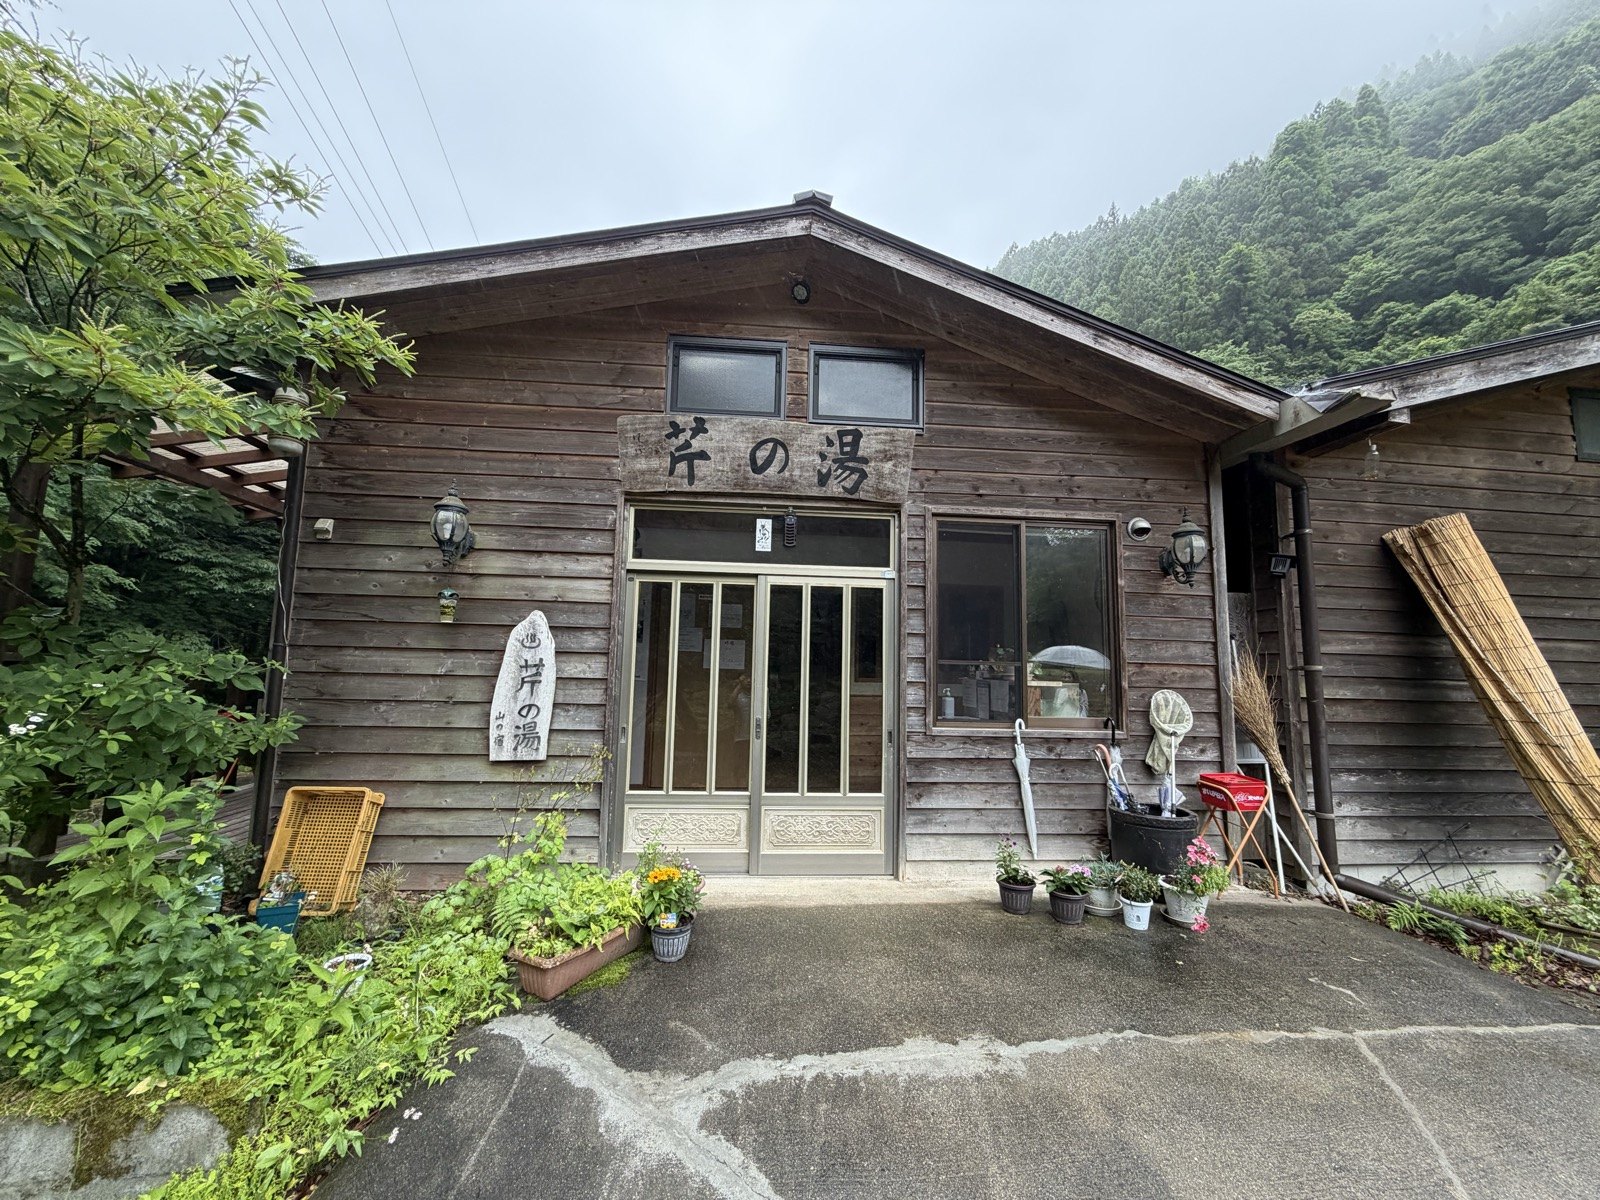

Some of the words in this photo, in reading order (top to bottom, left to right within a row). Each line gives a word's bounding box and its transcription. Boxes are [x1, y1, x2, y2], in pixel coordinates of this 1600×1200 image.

[664, 416, 870, 495] 芹の湯
[513, 657, 546, 752] 芹の湯
